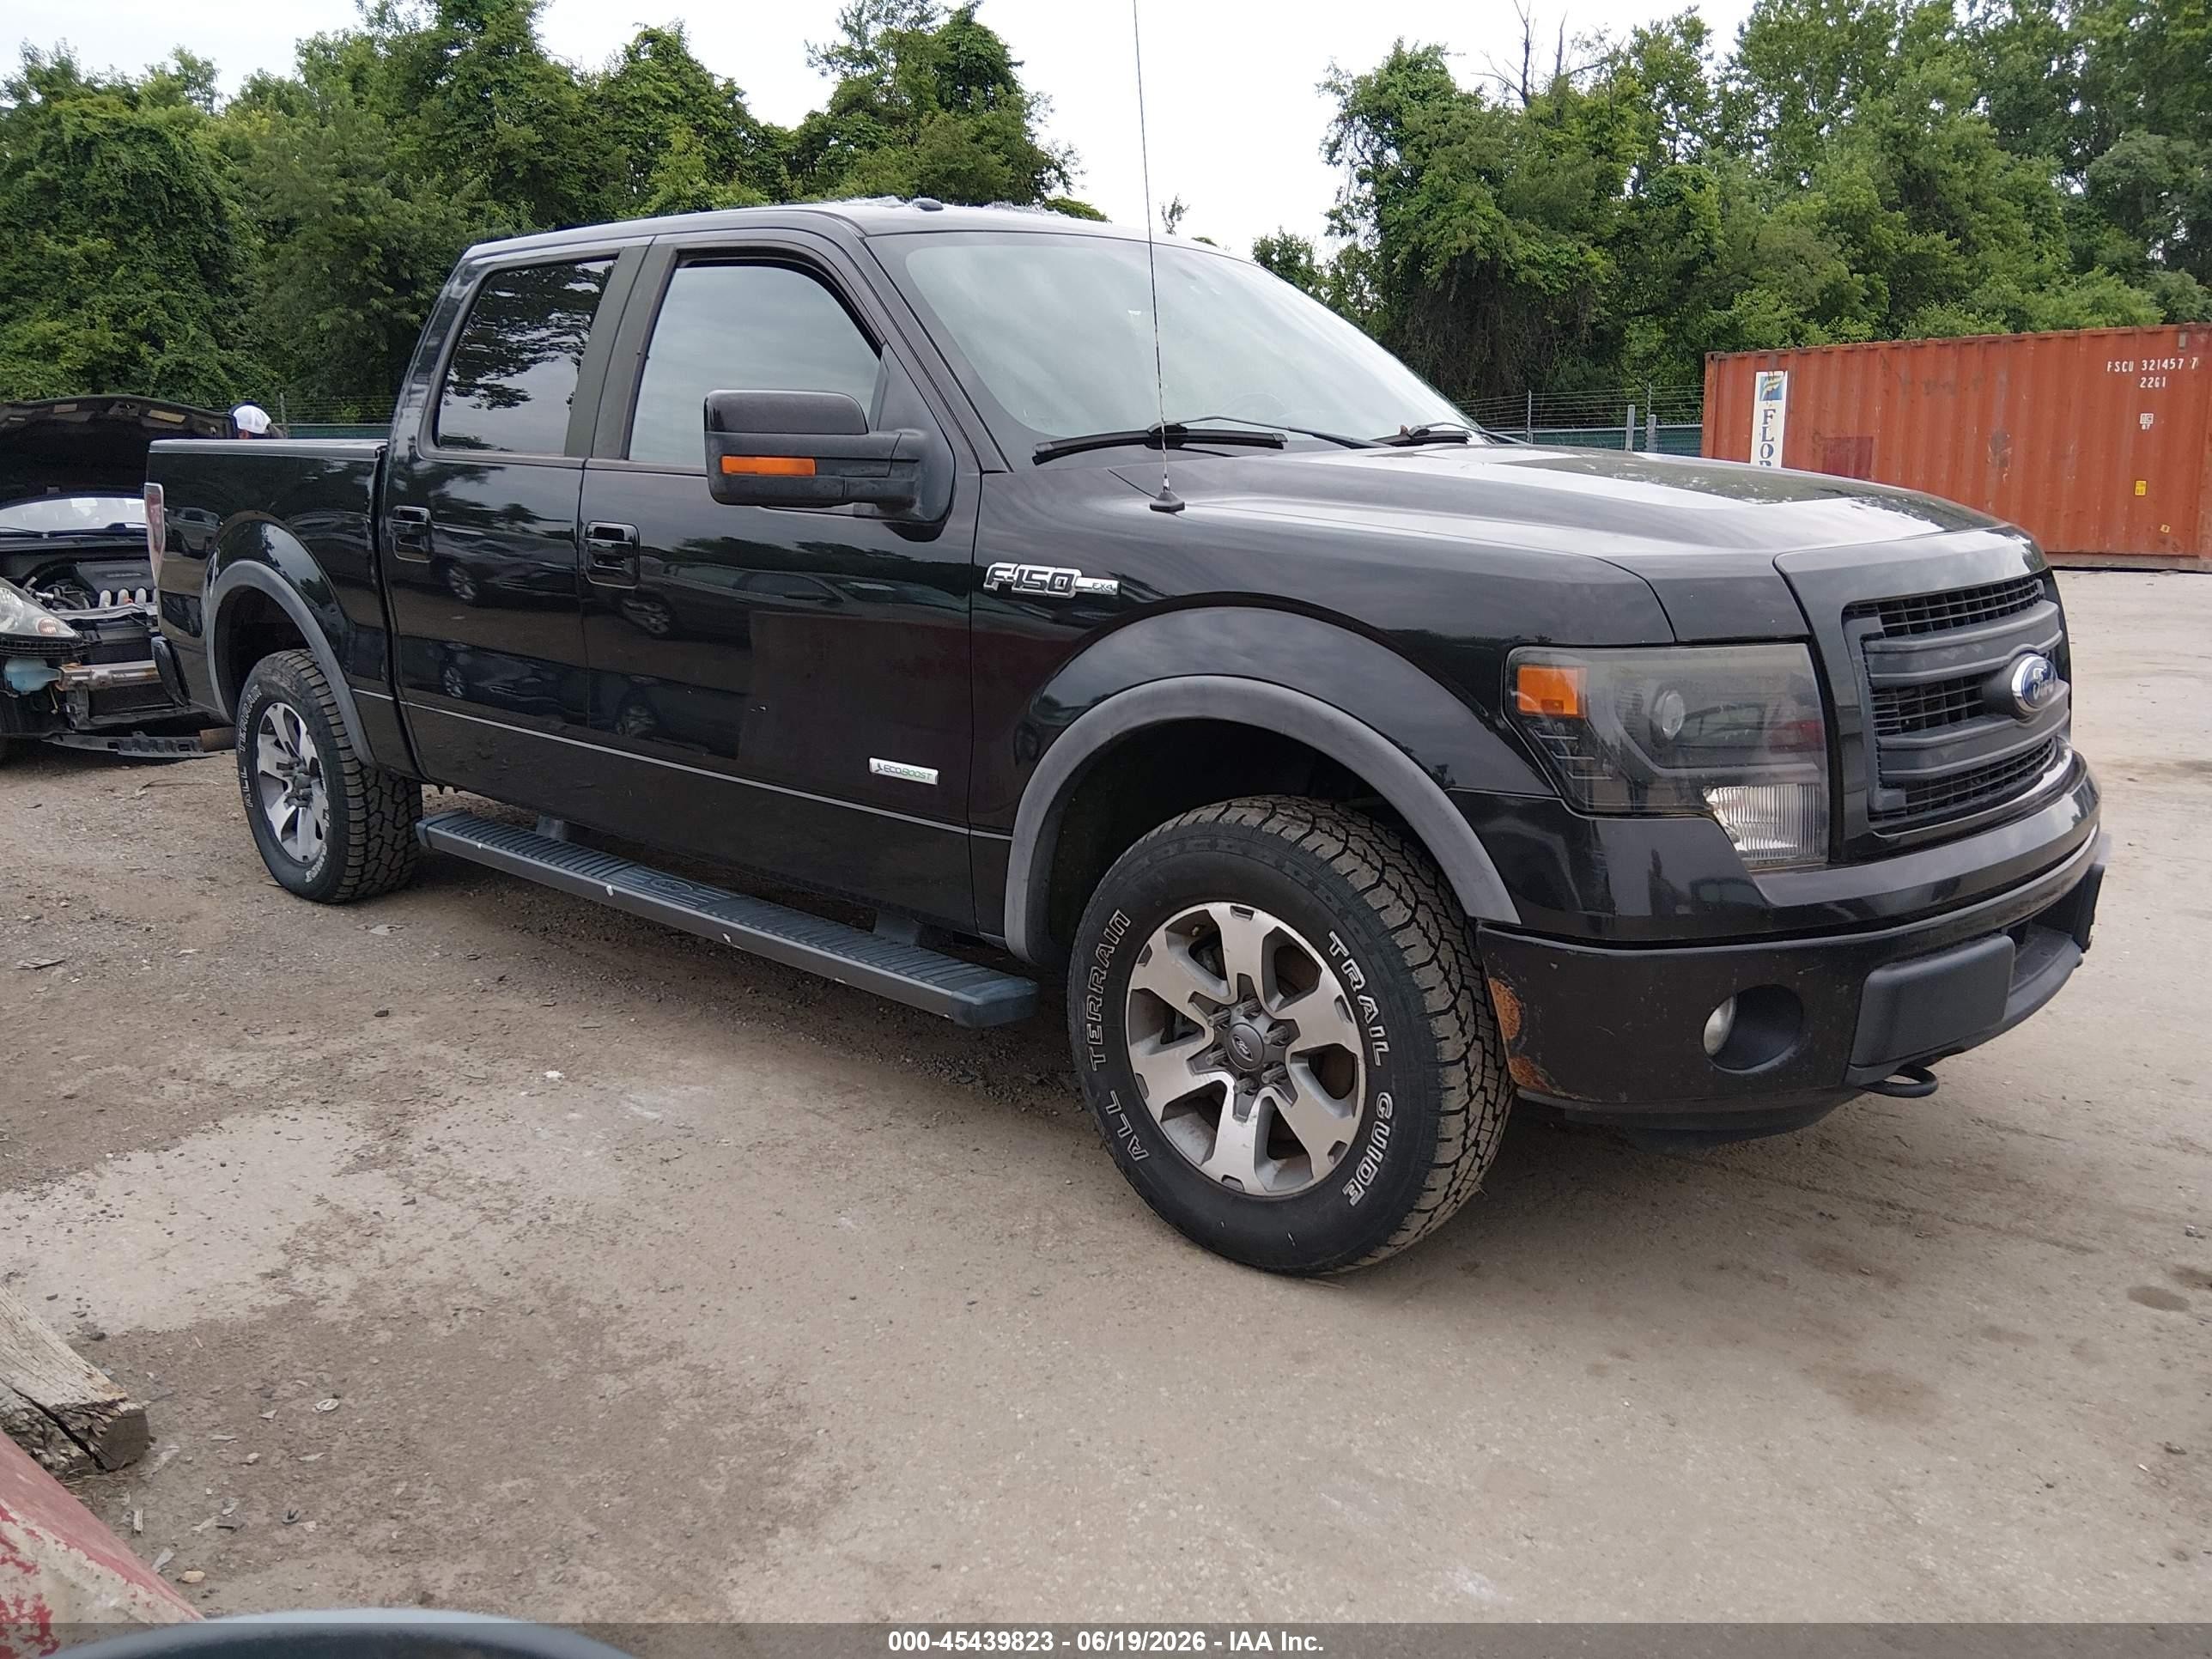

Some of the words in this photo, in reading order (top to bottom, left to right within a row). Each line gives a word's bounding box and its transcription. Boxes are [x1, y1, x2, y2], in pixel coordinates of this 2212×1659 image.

[2106, 361, 2135, 372] FSCU
[2141, 358, 2185, 371] 321457
[1086, 908, 1132, 1072] TERRAIN
[1328, 930, 1390, 1066] TRAIL
[1104, 1090, 1149, 1162] ALL
[1341, 1091, 1394, 1206] GUIDE
